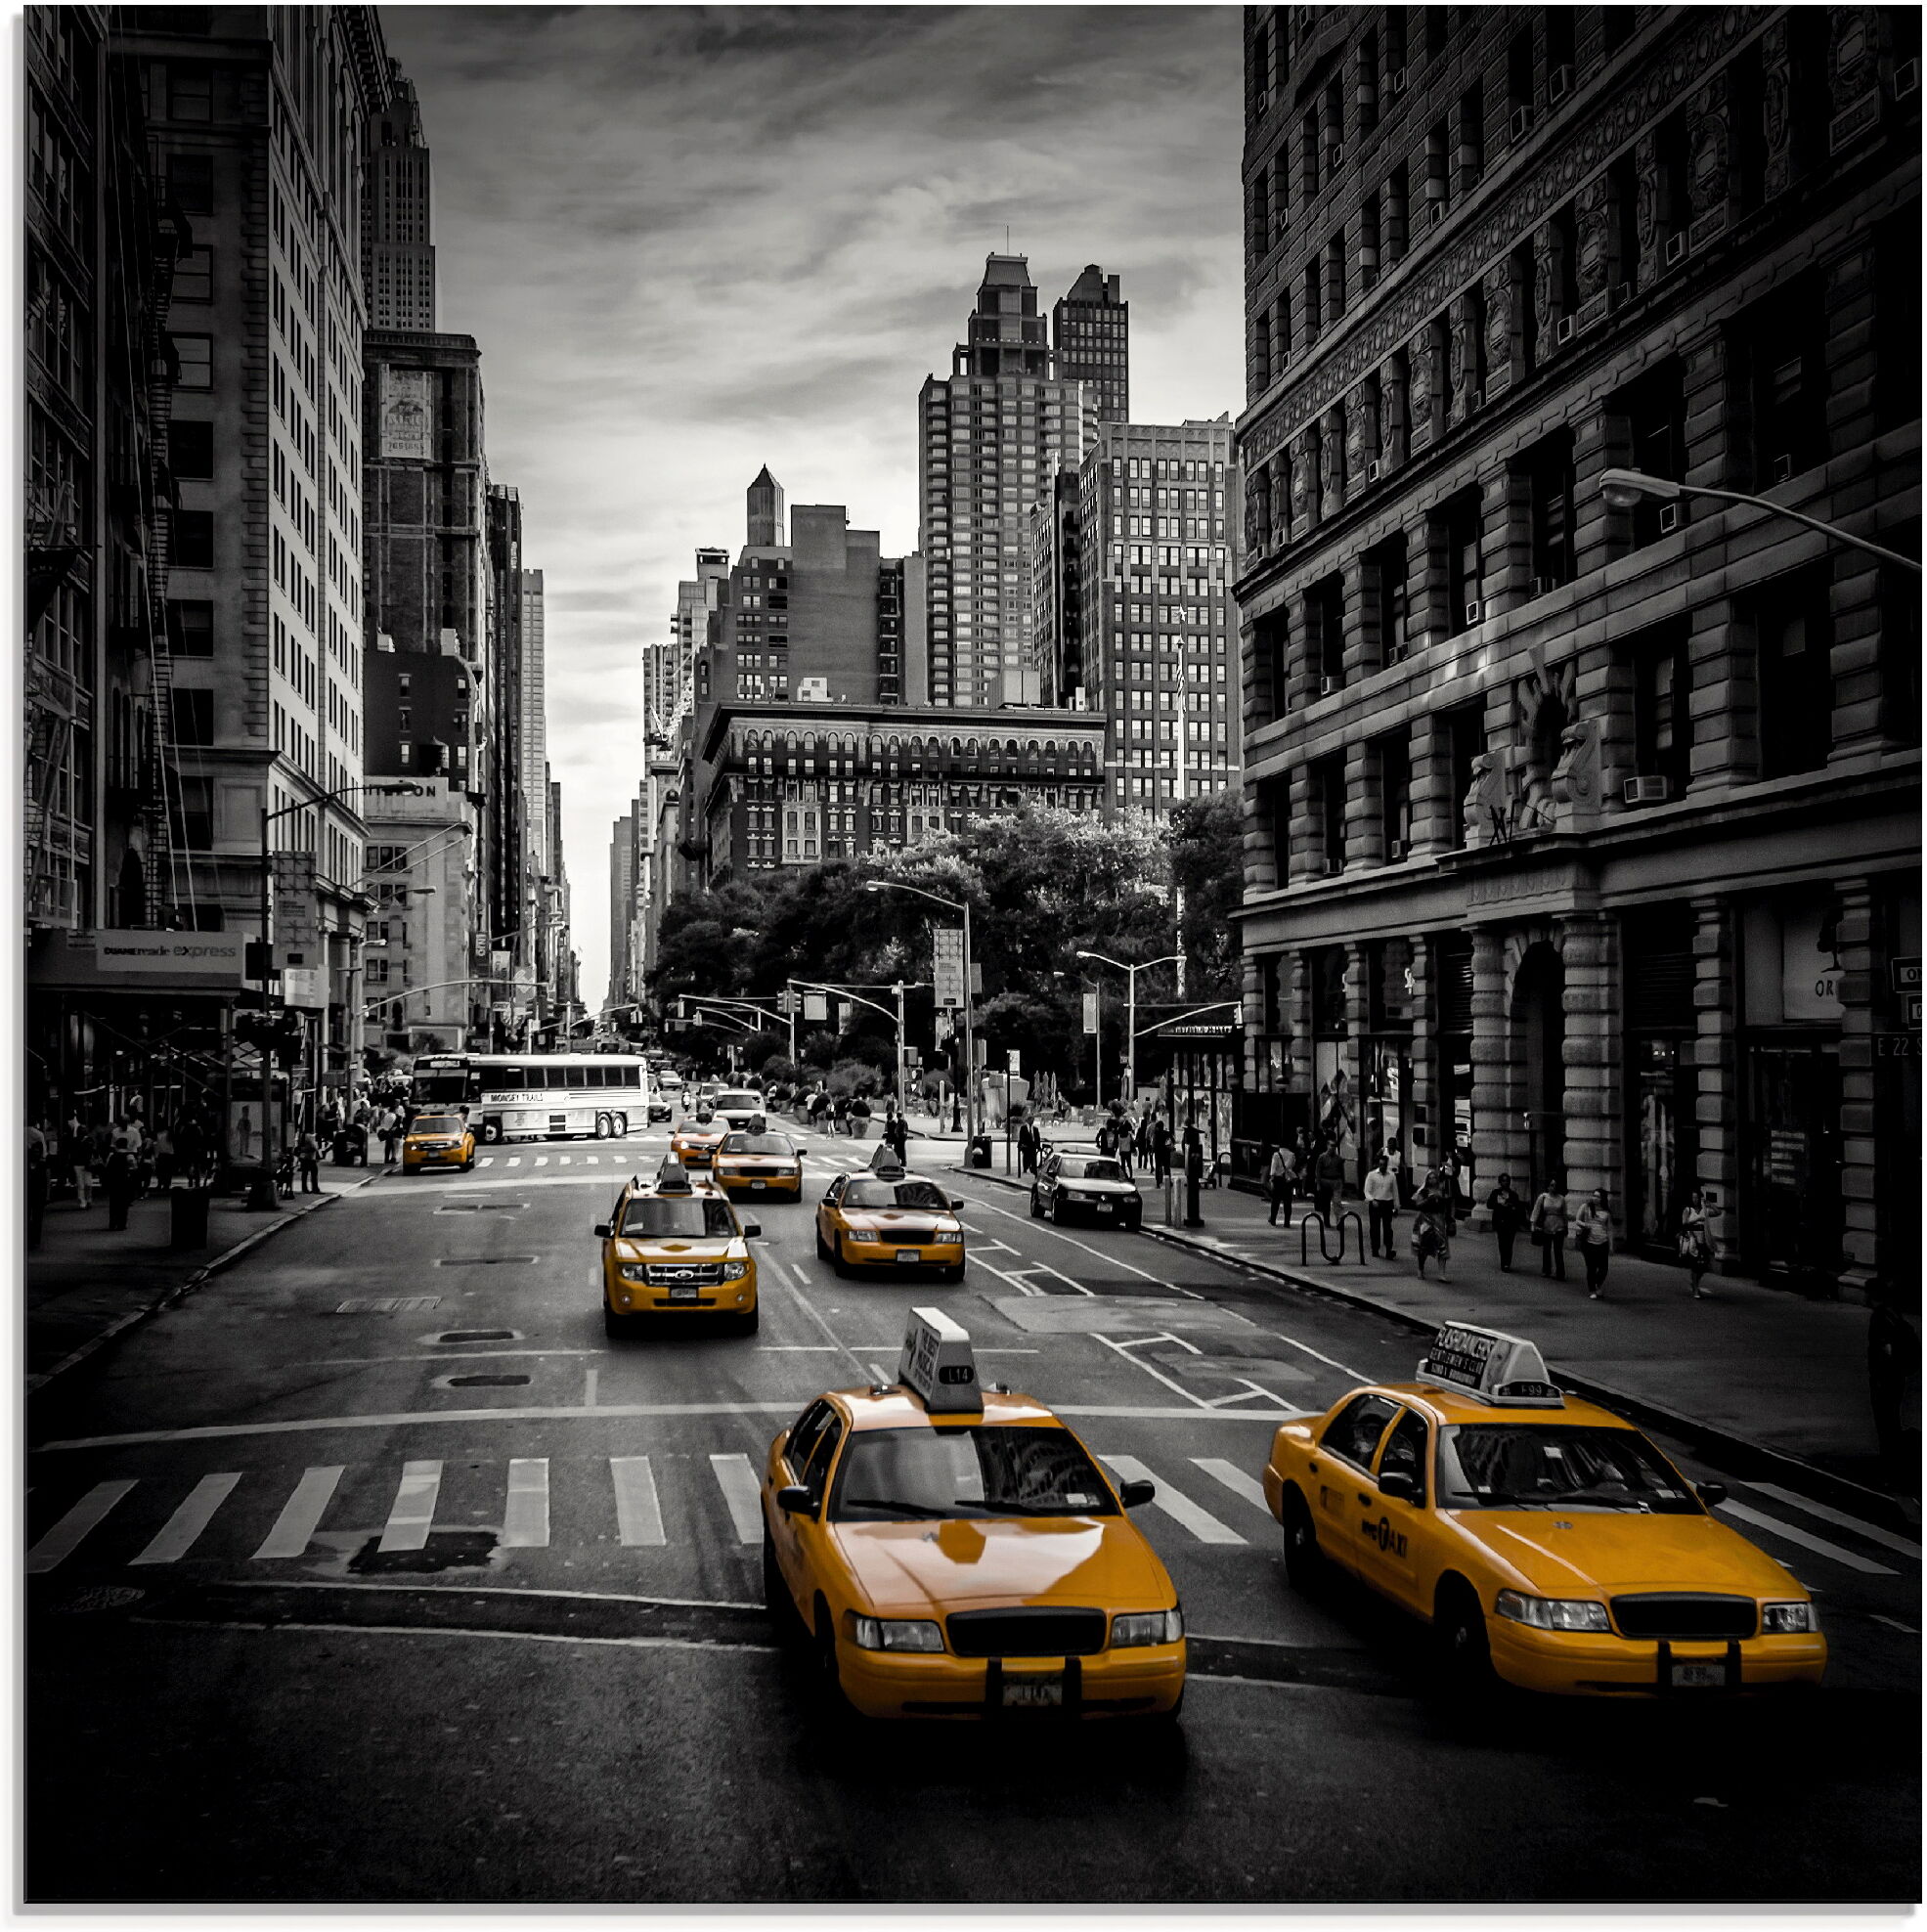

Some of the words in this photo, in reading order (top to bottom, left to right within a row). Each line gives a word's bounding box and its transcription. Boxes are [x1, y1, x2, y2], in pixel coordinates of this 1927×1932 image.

[173, 945, 237, 959] express
[1878, 1038, 1886, 1056] E
[1893, 1037, 1909, 1056] 22
[948, 1368, 968, 1383] L14
[1521, 1384, 1542, 1396] F99
